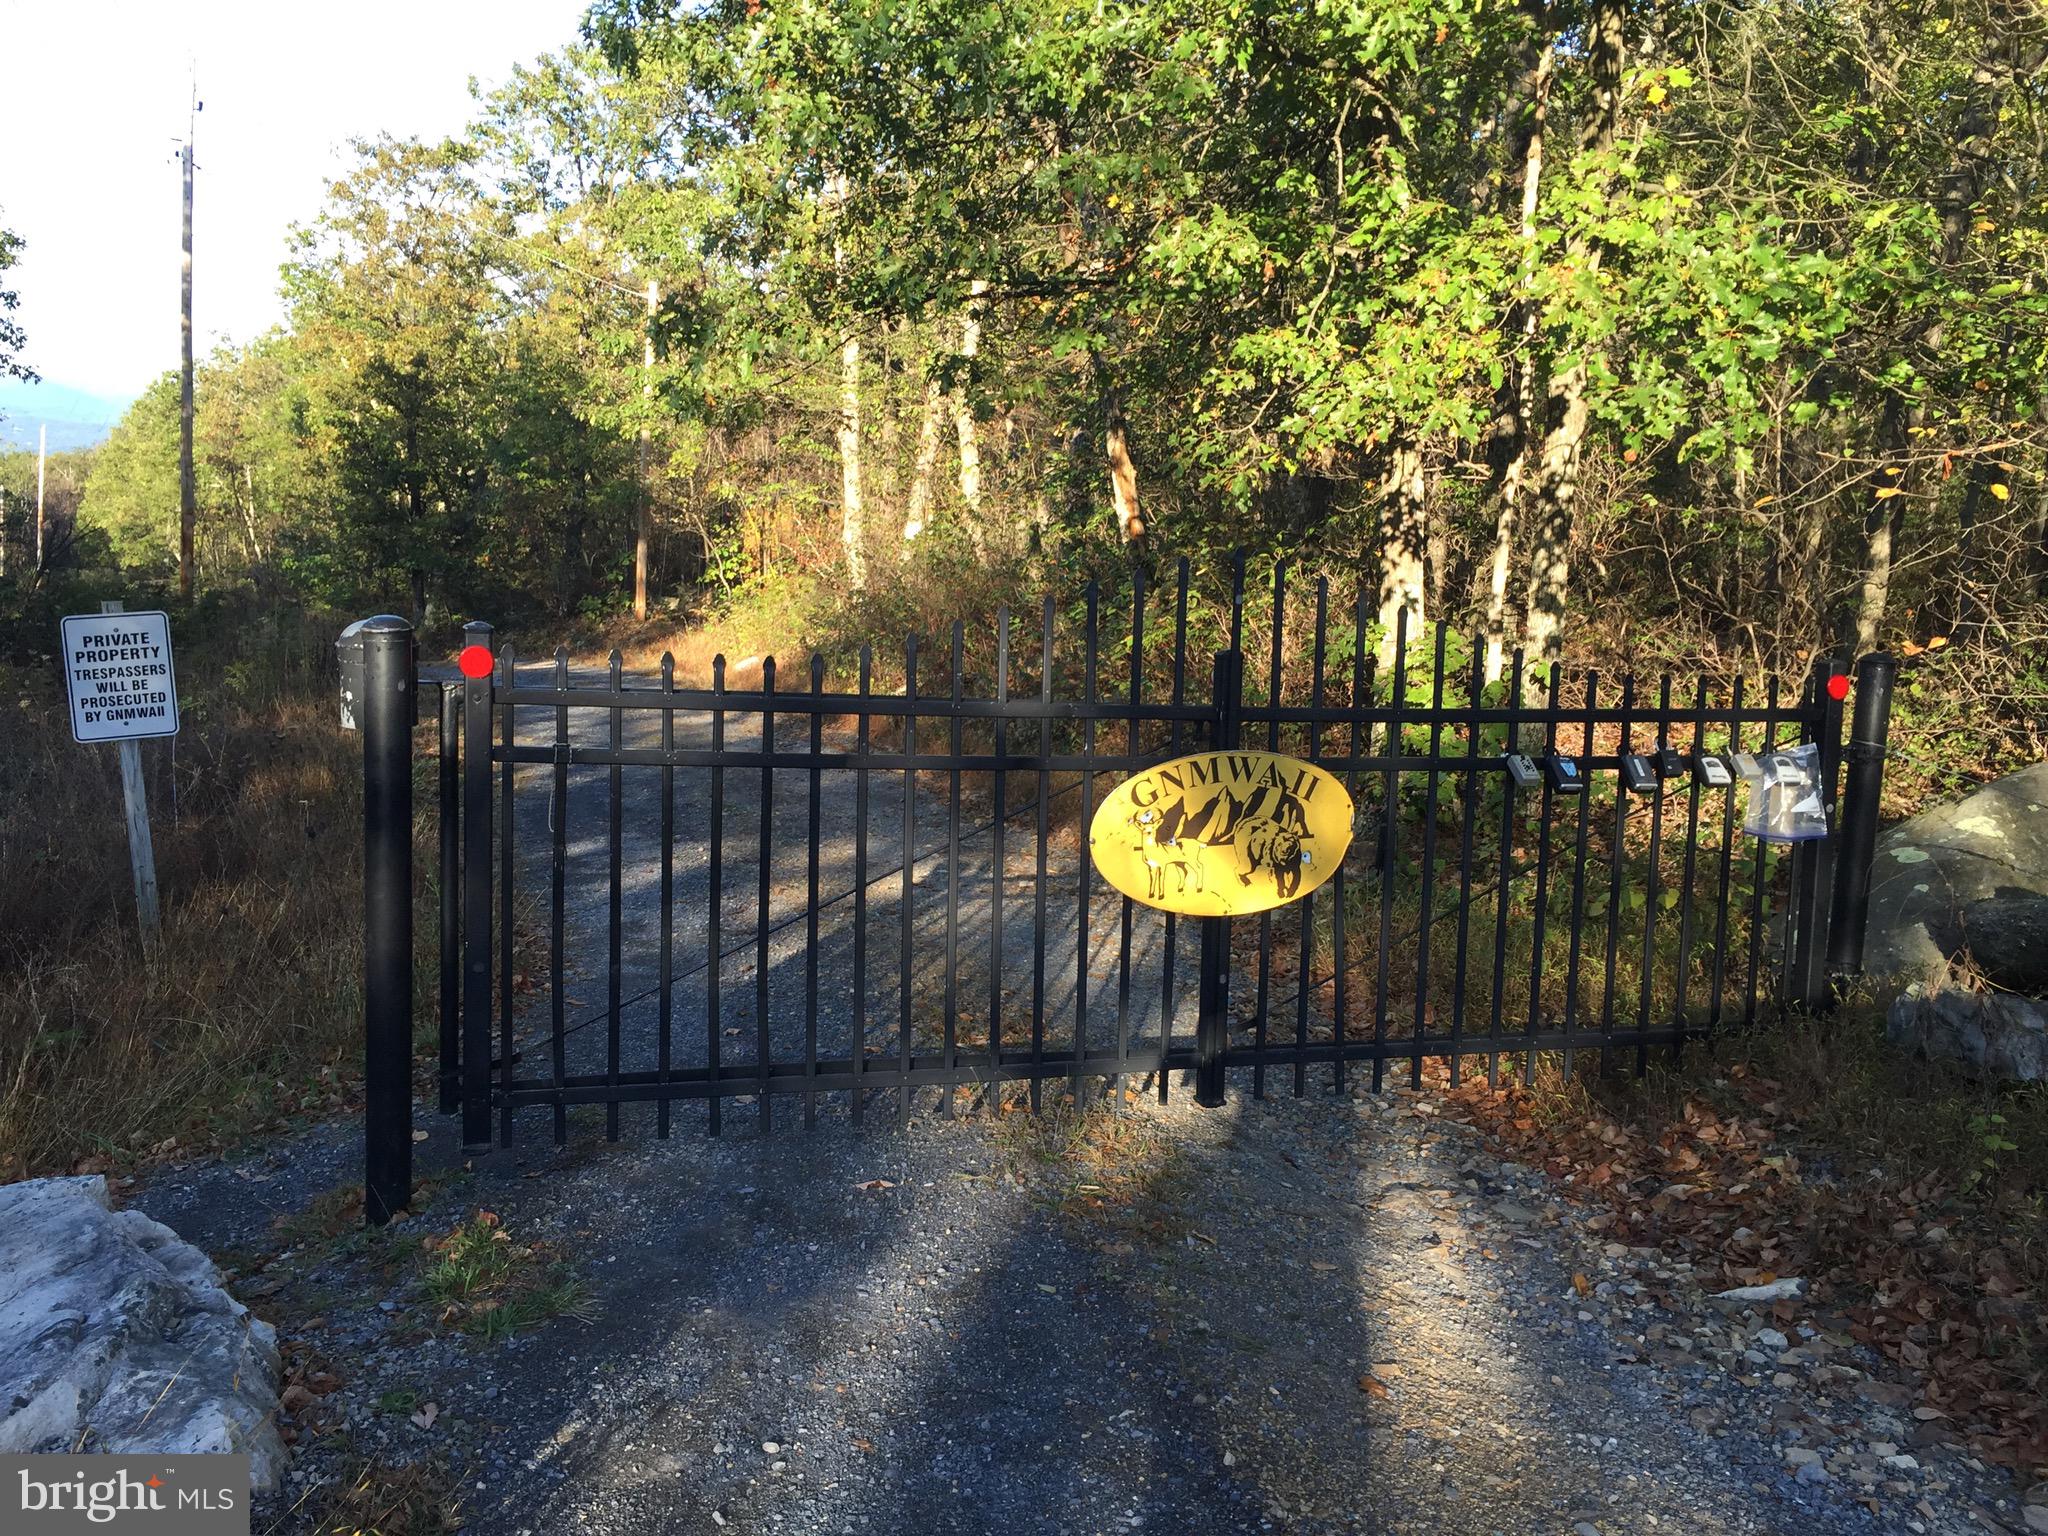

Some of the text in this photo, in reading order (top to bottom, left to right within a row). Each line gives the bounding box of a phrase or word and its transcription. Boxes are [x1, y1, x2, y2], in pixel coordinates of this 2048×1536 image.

[83, 632, 150, 648] PRIVATE
[75, 646, 160, 663] PROPERTY
[74, 664, 166, 681] TRESPASSERS
[96, 679, 148, 694] WILL BE
[81, 692, 166, 709] PROSECUTED
[85, 711, 101, 723] BY
